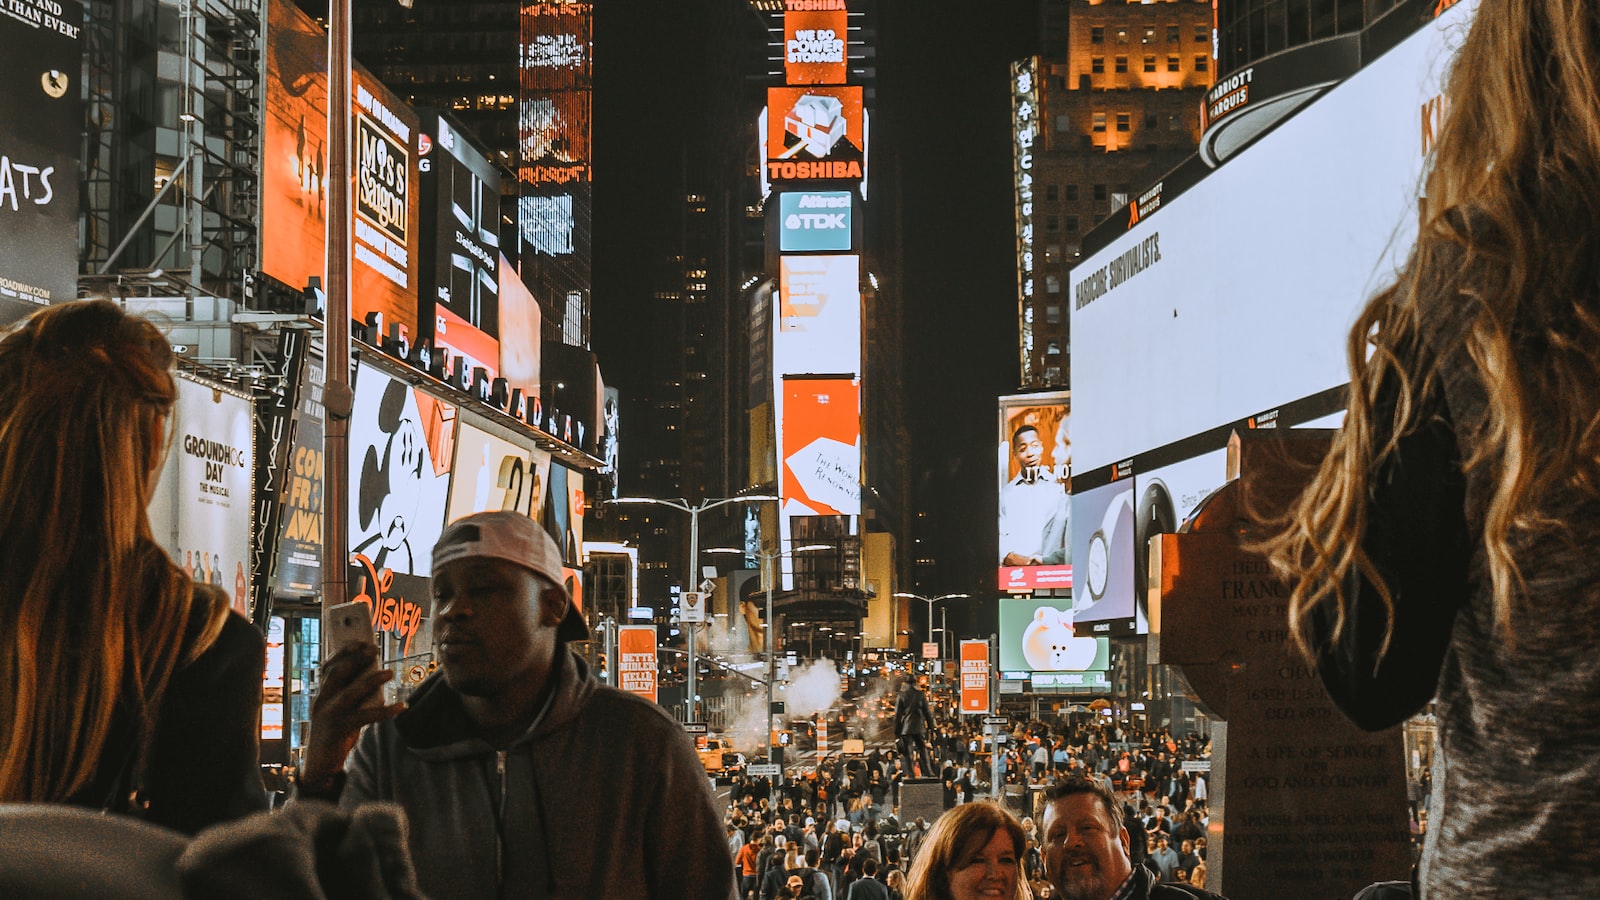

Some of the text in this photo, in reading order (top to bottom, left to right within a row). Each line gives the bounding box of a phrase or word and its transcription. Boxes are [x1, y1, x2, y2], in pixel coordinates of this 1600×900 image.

[9, 0, 41, 23] THAN
[785, 0, 846, 11] TOSHIBA
[795, 29, 836, 41] WE DO
[787, 40, 844, 53] POWER
[768, 161, 862, 179] TOSHIBA
[799, 213, 846, 229] TDK
[1076, 266, 1107, 311] HARDCORE
[454, 355, 585, 448] BROADWAY
[184, 434, 245, 468] GROUNDHOG
[206, 461, 224, 483] DAY
[209, 485, 230, 497] MUSICAL
